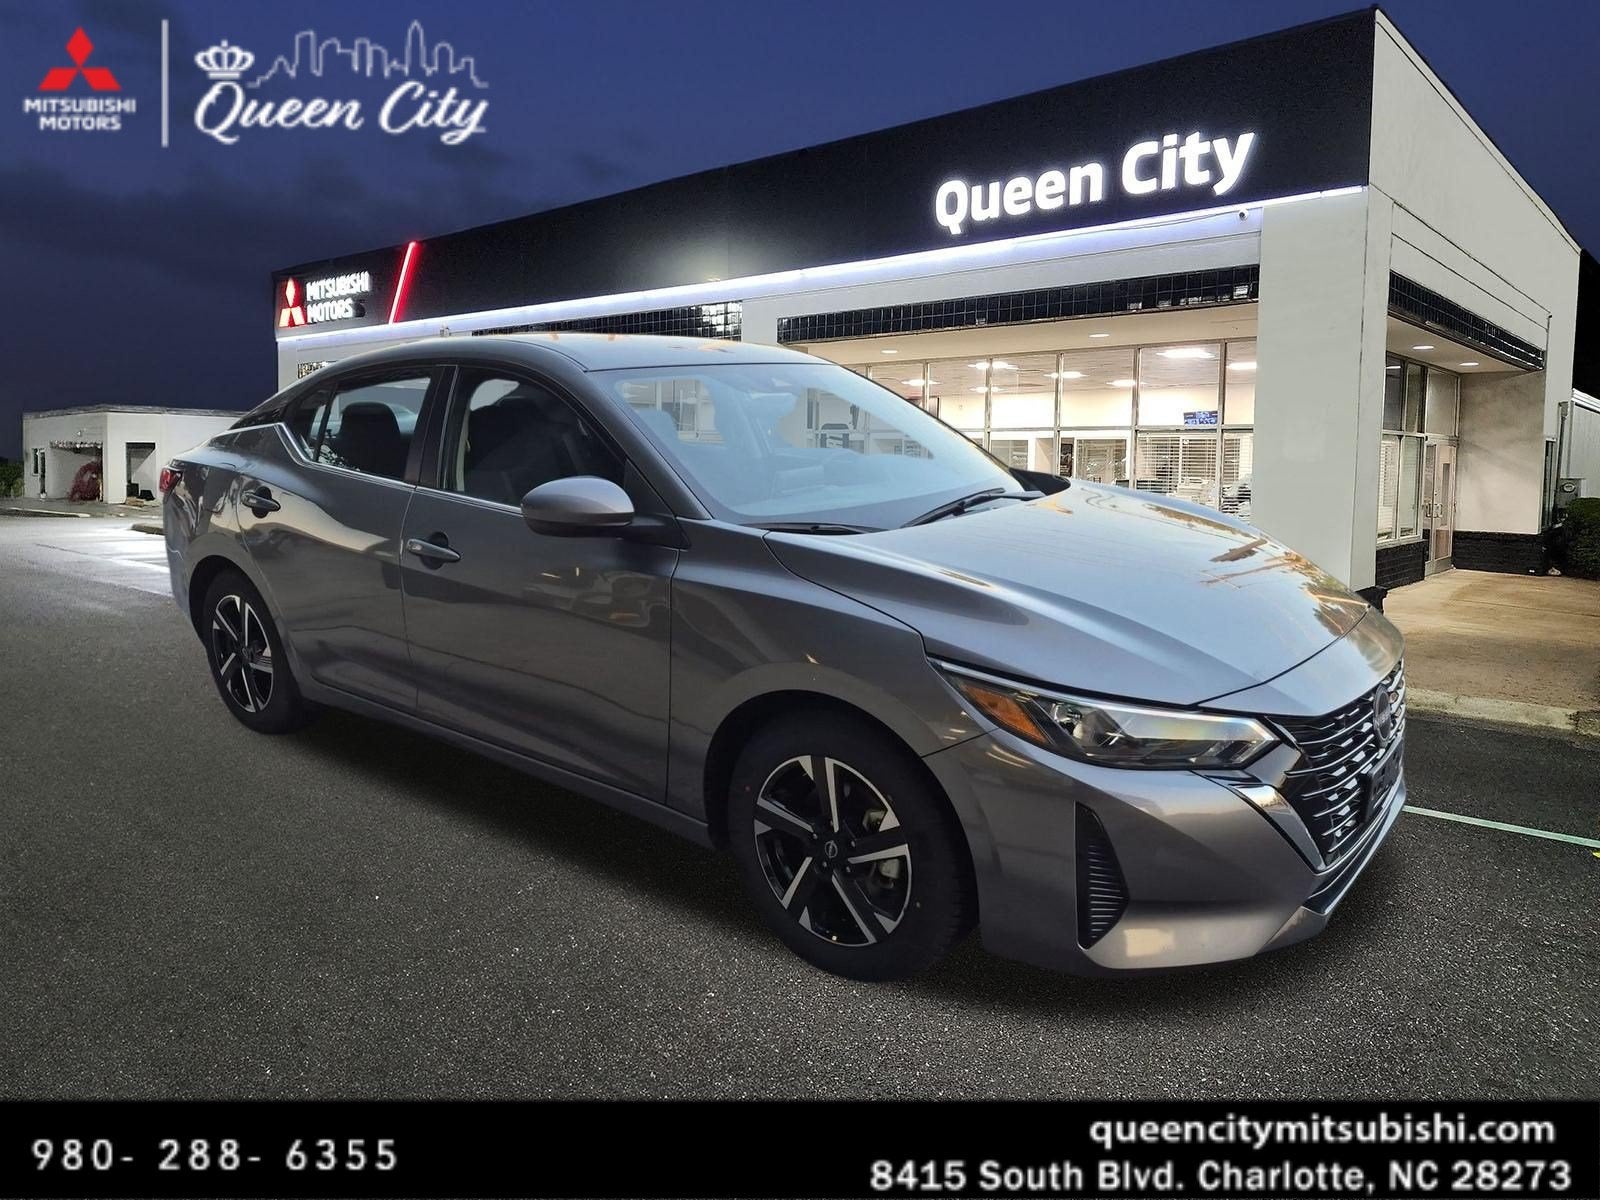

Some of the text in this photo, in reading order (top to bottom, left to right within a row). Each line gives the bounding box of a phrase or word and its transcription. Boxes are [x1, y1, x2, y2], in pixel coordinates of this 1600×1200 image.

[935, 131, 1255, 235] Queen City
[306, 270, 370, 302] MITSUBISHI
[306, 298, 354, 324] MOTORS
